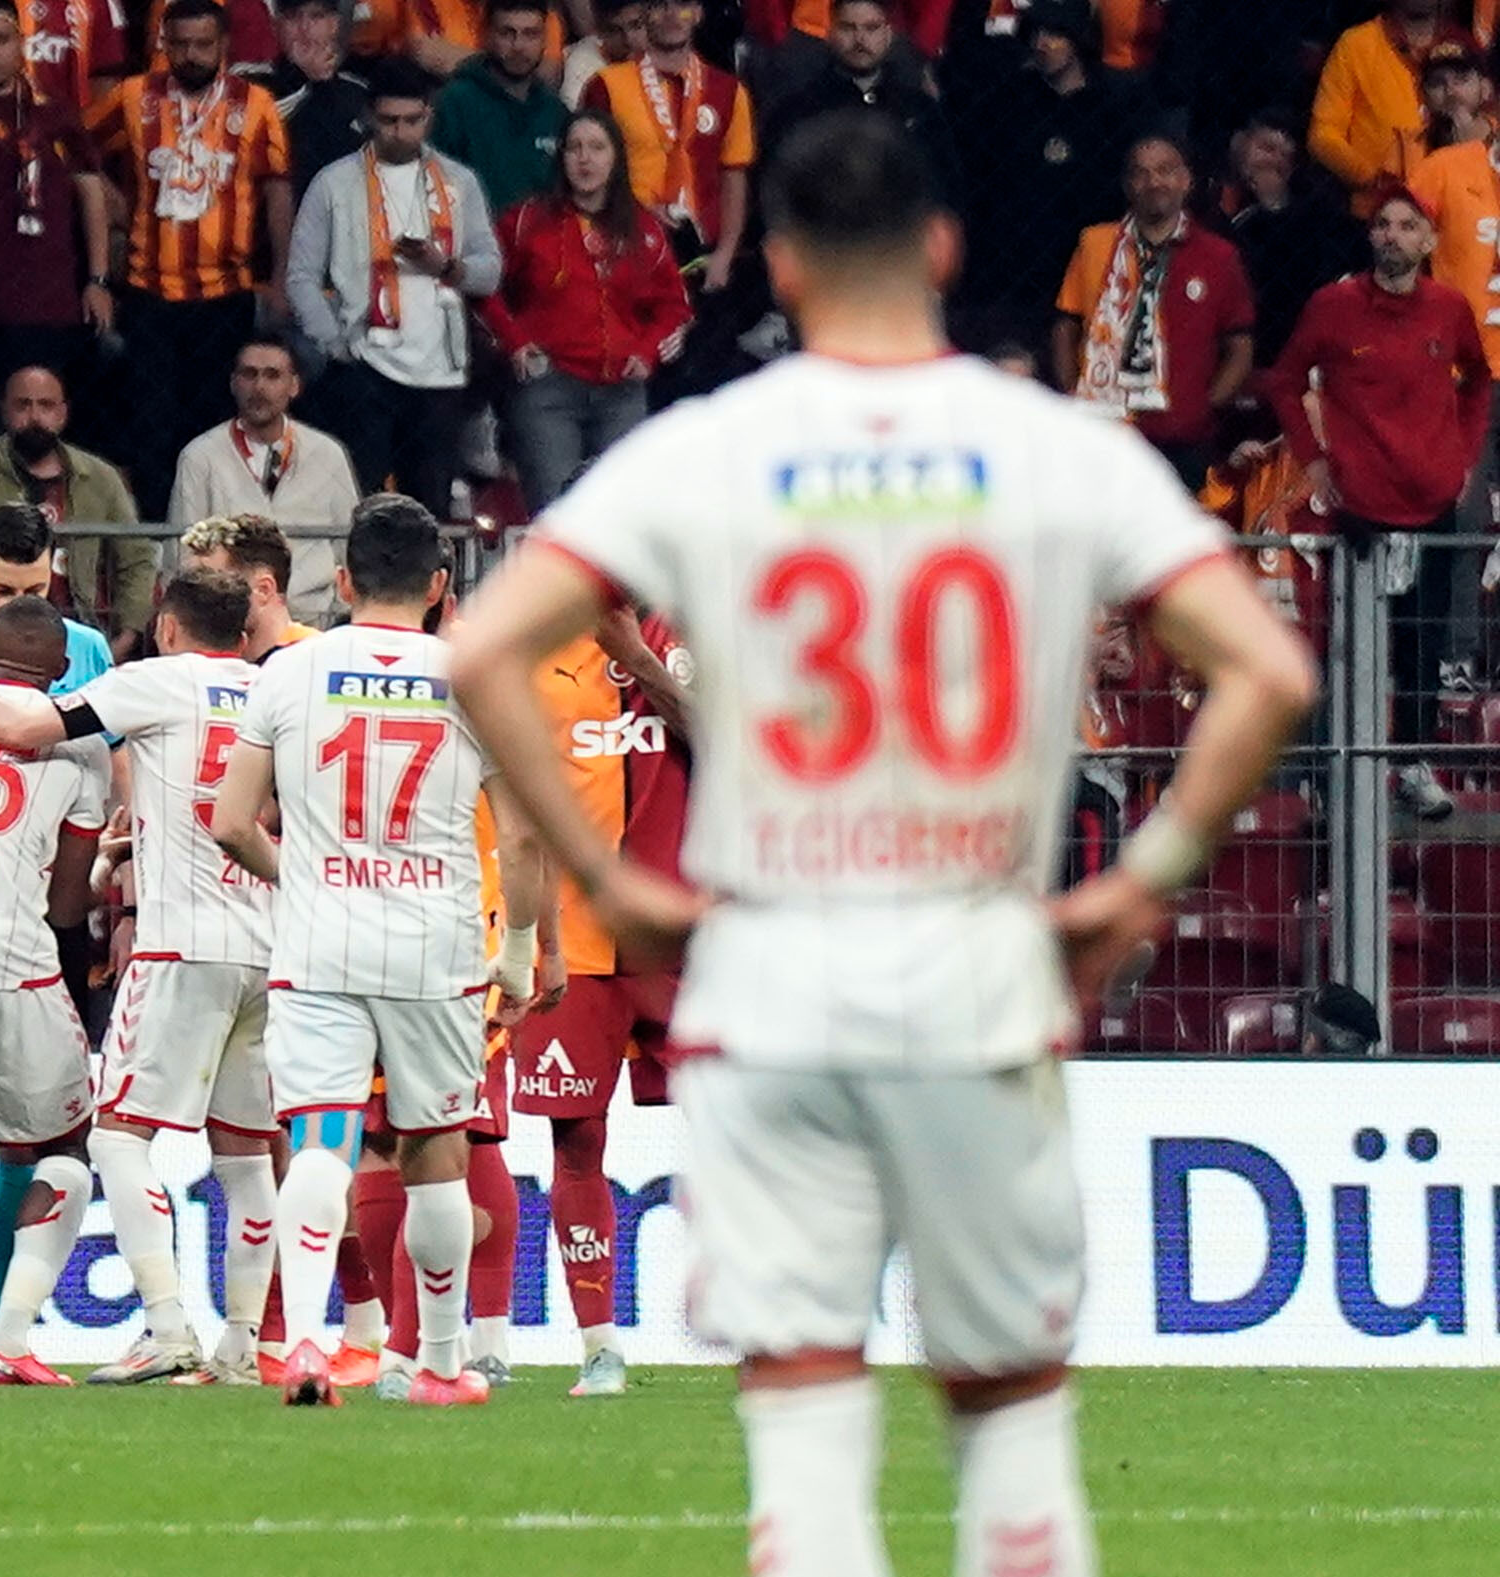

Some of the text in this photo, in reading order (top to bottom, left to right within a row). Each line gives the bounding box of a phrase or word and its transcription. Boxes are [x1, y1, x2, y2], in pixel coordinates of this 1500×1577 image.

[754, 548, 1018, 784] 30
[218, 690, 248, 711] ak
[341, 676, 433, 701] aksa
[317, 712, 450, 844] 17
[324, 857, 444, 889] EMRAH
[561, 1239, 611, 1264] NGN
